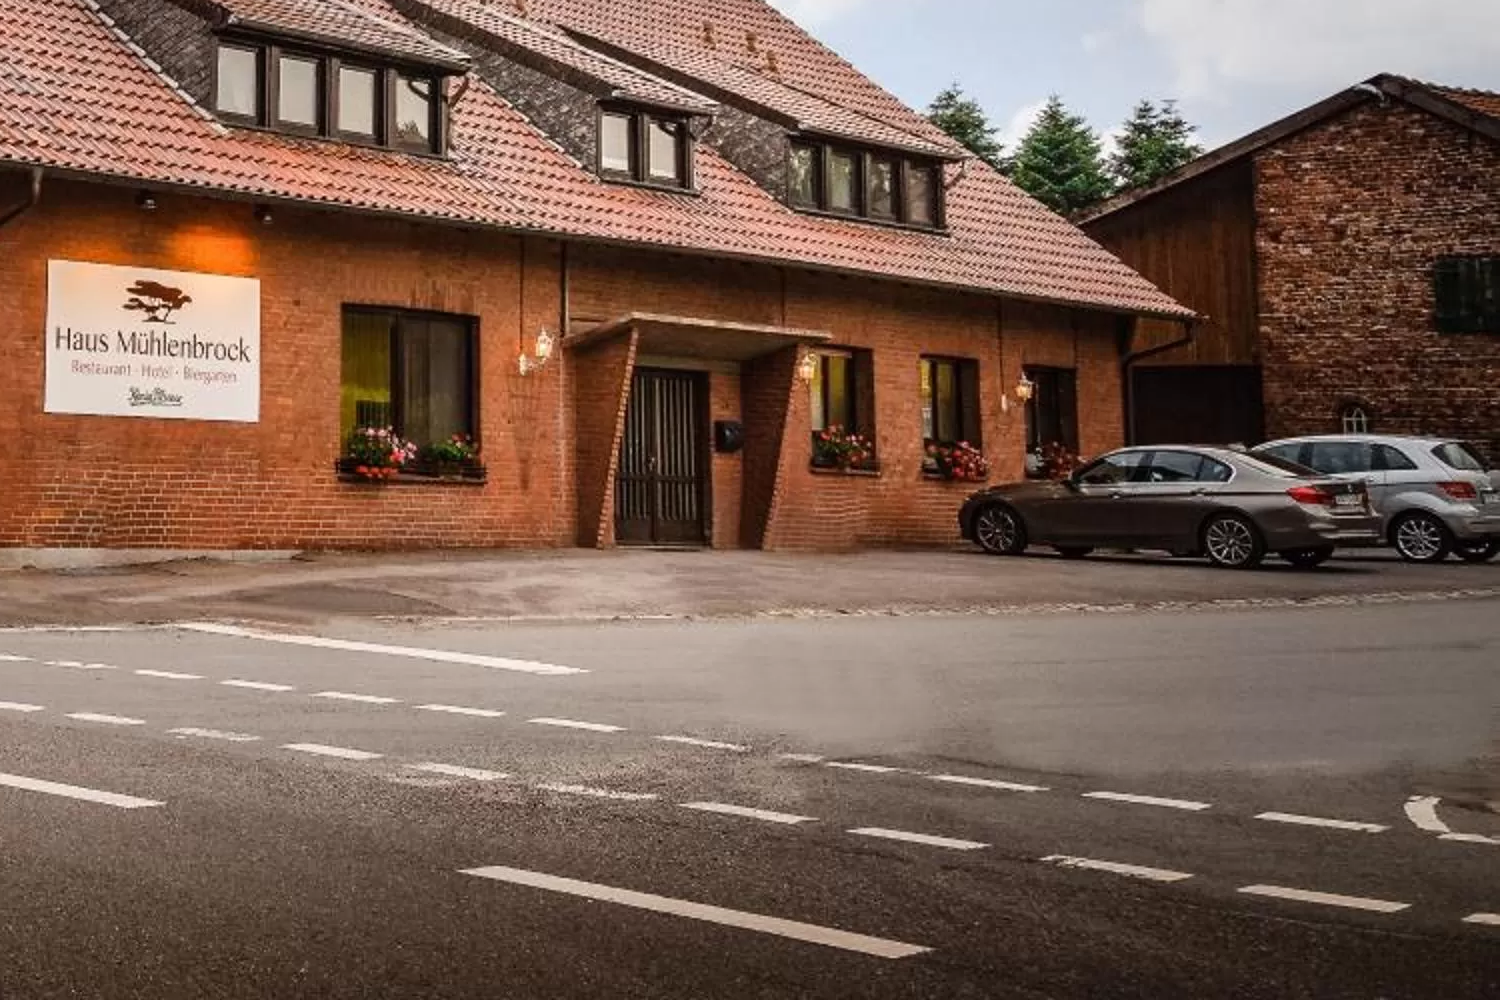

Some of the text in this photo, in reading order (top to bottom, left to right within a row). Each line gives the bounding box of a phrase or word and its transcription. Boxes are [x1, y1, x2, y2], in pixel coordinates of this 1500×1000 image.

[55, 326, 251, 363] Haus Mühlenbrock
[71, 359, 237, 384] Restaurant Hotel Biergarten
